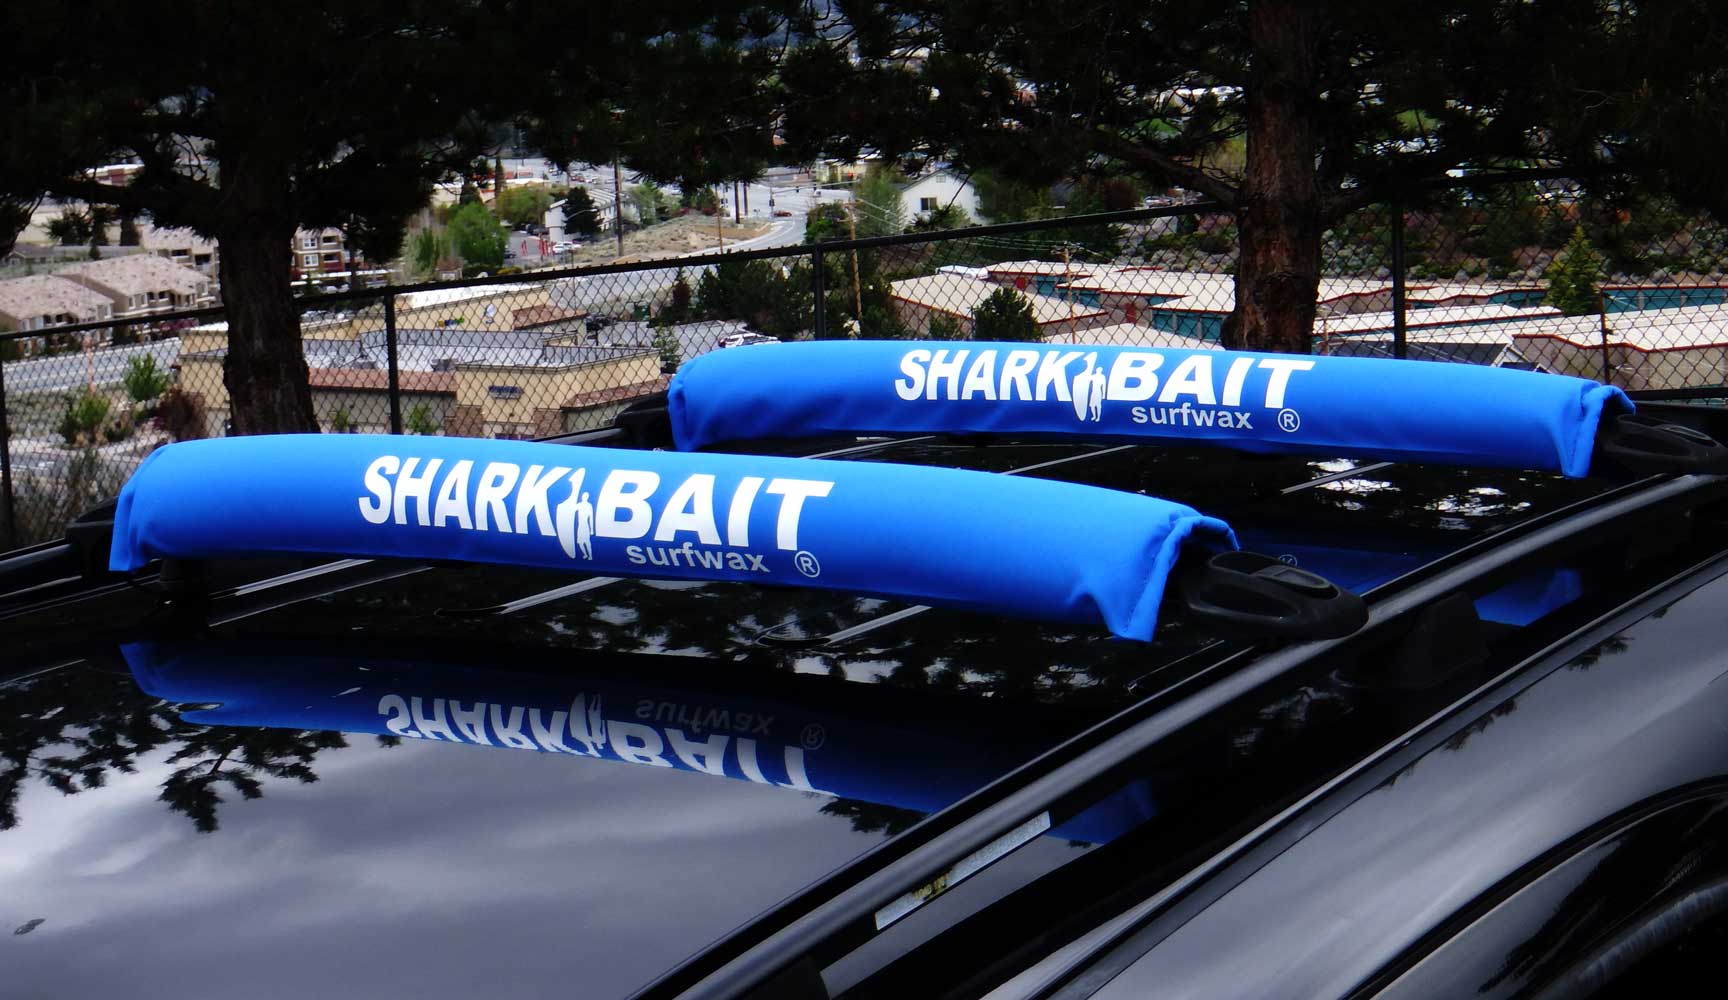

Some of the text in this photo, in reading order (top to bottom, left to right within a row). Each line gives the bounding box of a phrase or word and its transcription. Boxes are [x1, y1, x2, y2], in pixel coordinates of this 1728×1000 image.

[894, 349, 1316, 410] SHARK BAIT
[1131, 402, 1253, 430] surfwax
[358, 455, 835, 551] SHARK BAIT
[626, 541, 770, 573] surfwax
